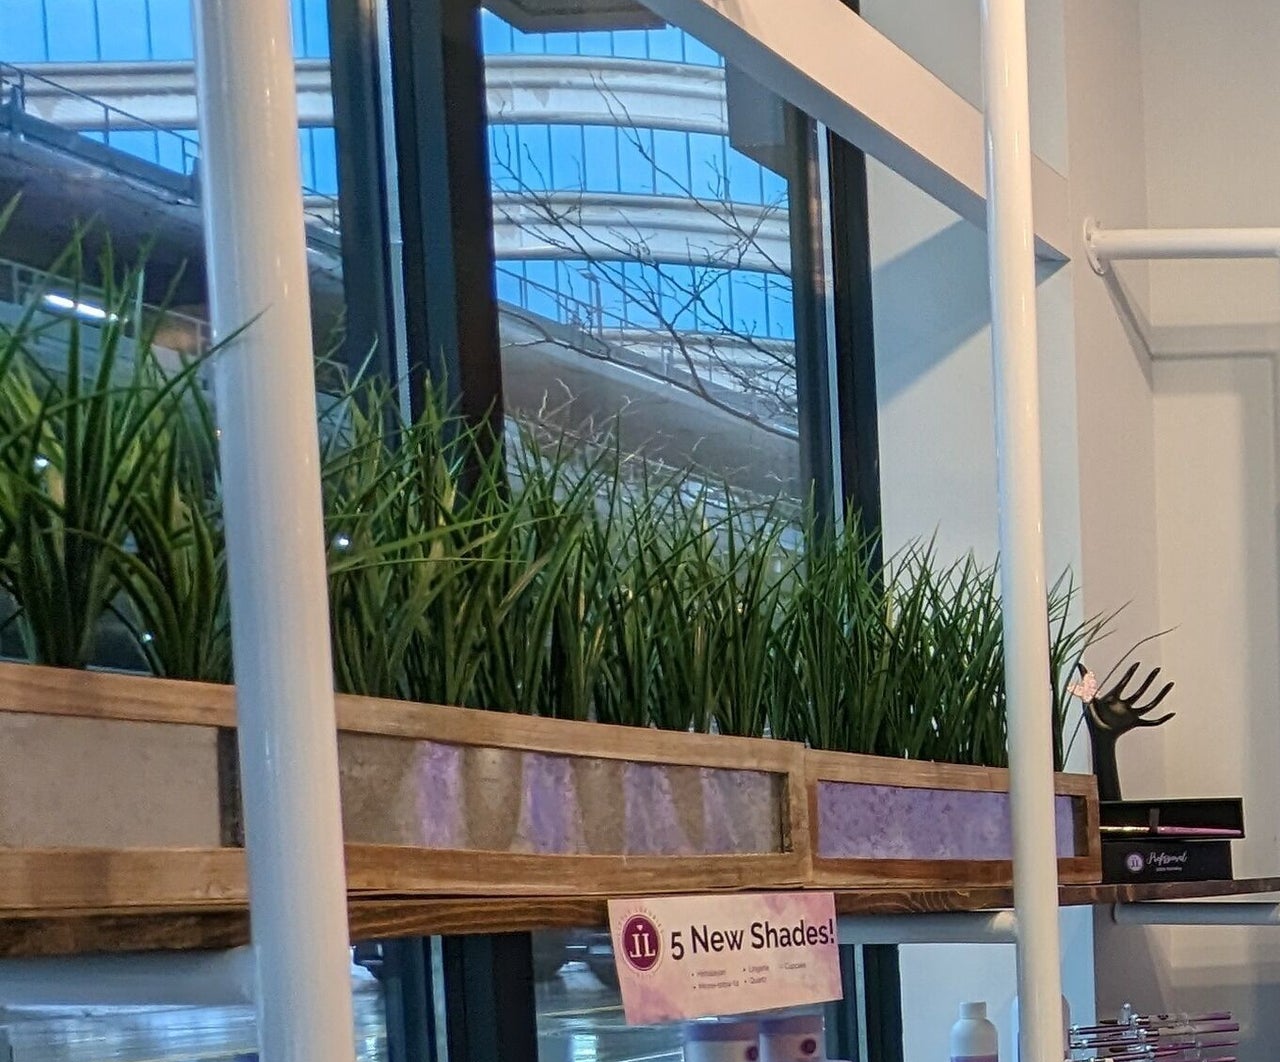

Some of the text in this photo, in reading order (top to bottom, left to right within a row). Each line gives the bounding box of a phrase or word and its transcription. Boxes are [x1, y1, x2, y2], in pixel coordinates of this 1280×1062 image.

[671, 918, 835, 961] 5 New Shades!
